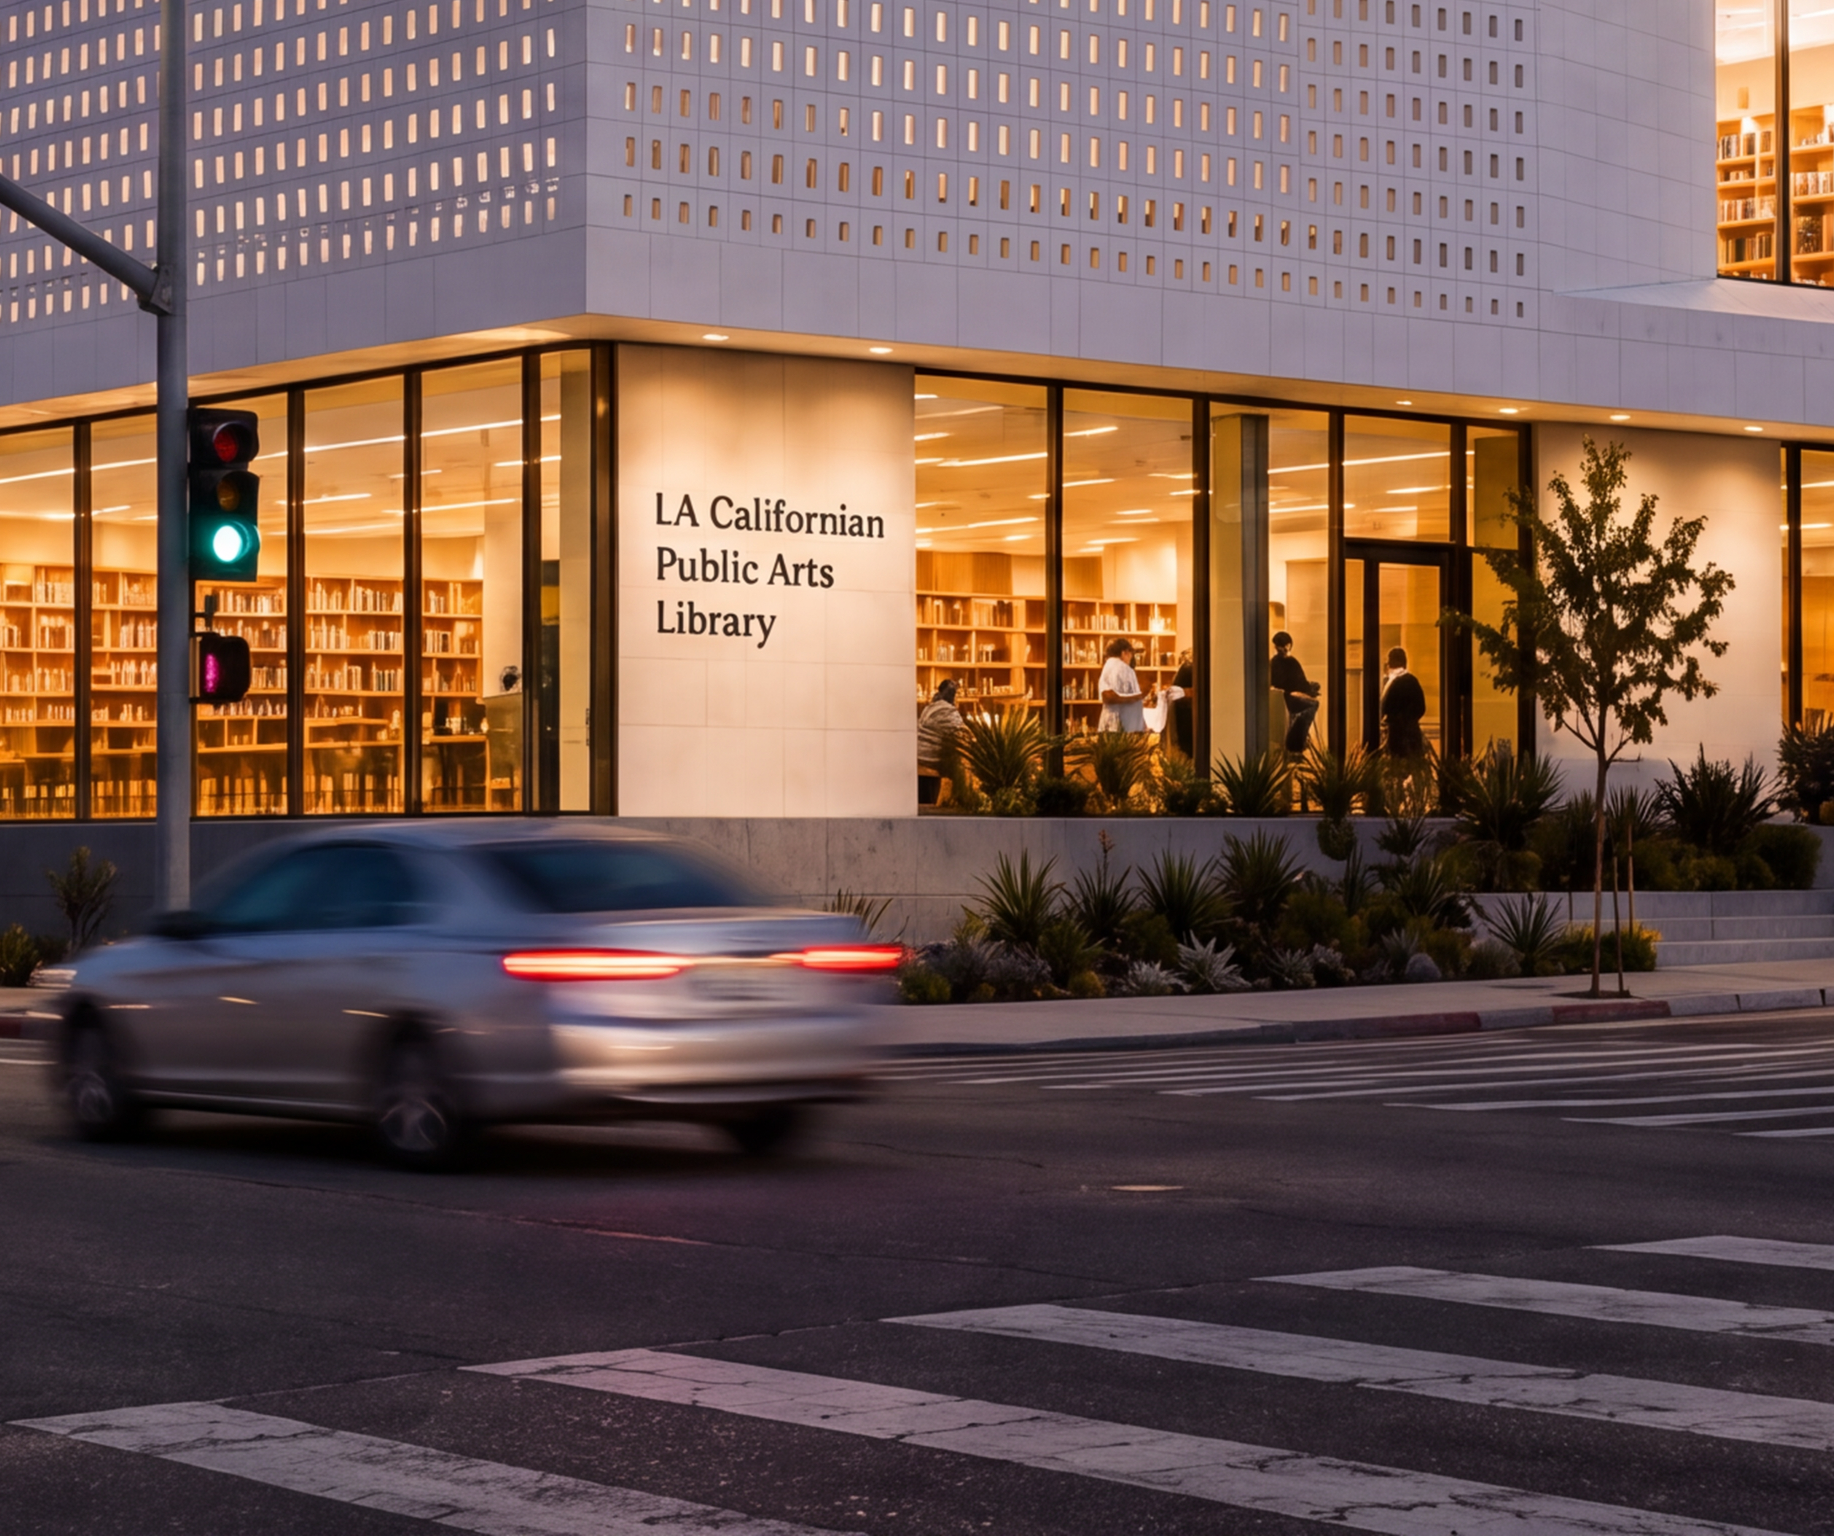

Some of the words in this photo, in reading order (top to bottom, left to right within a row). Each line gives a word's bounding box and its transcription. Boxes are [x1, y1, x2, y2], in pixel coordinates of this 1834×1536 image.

[656, 492, 700, 527] LA
[710, 495, 885, 539] Californian
[656, 546, 759, 585] Public
[767, 553, 835, 589] Arts
[657, 600, 777, 649] Library
